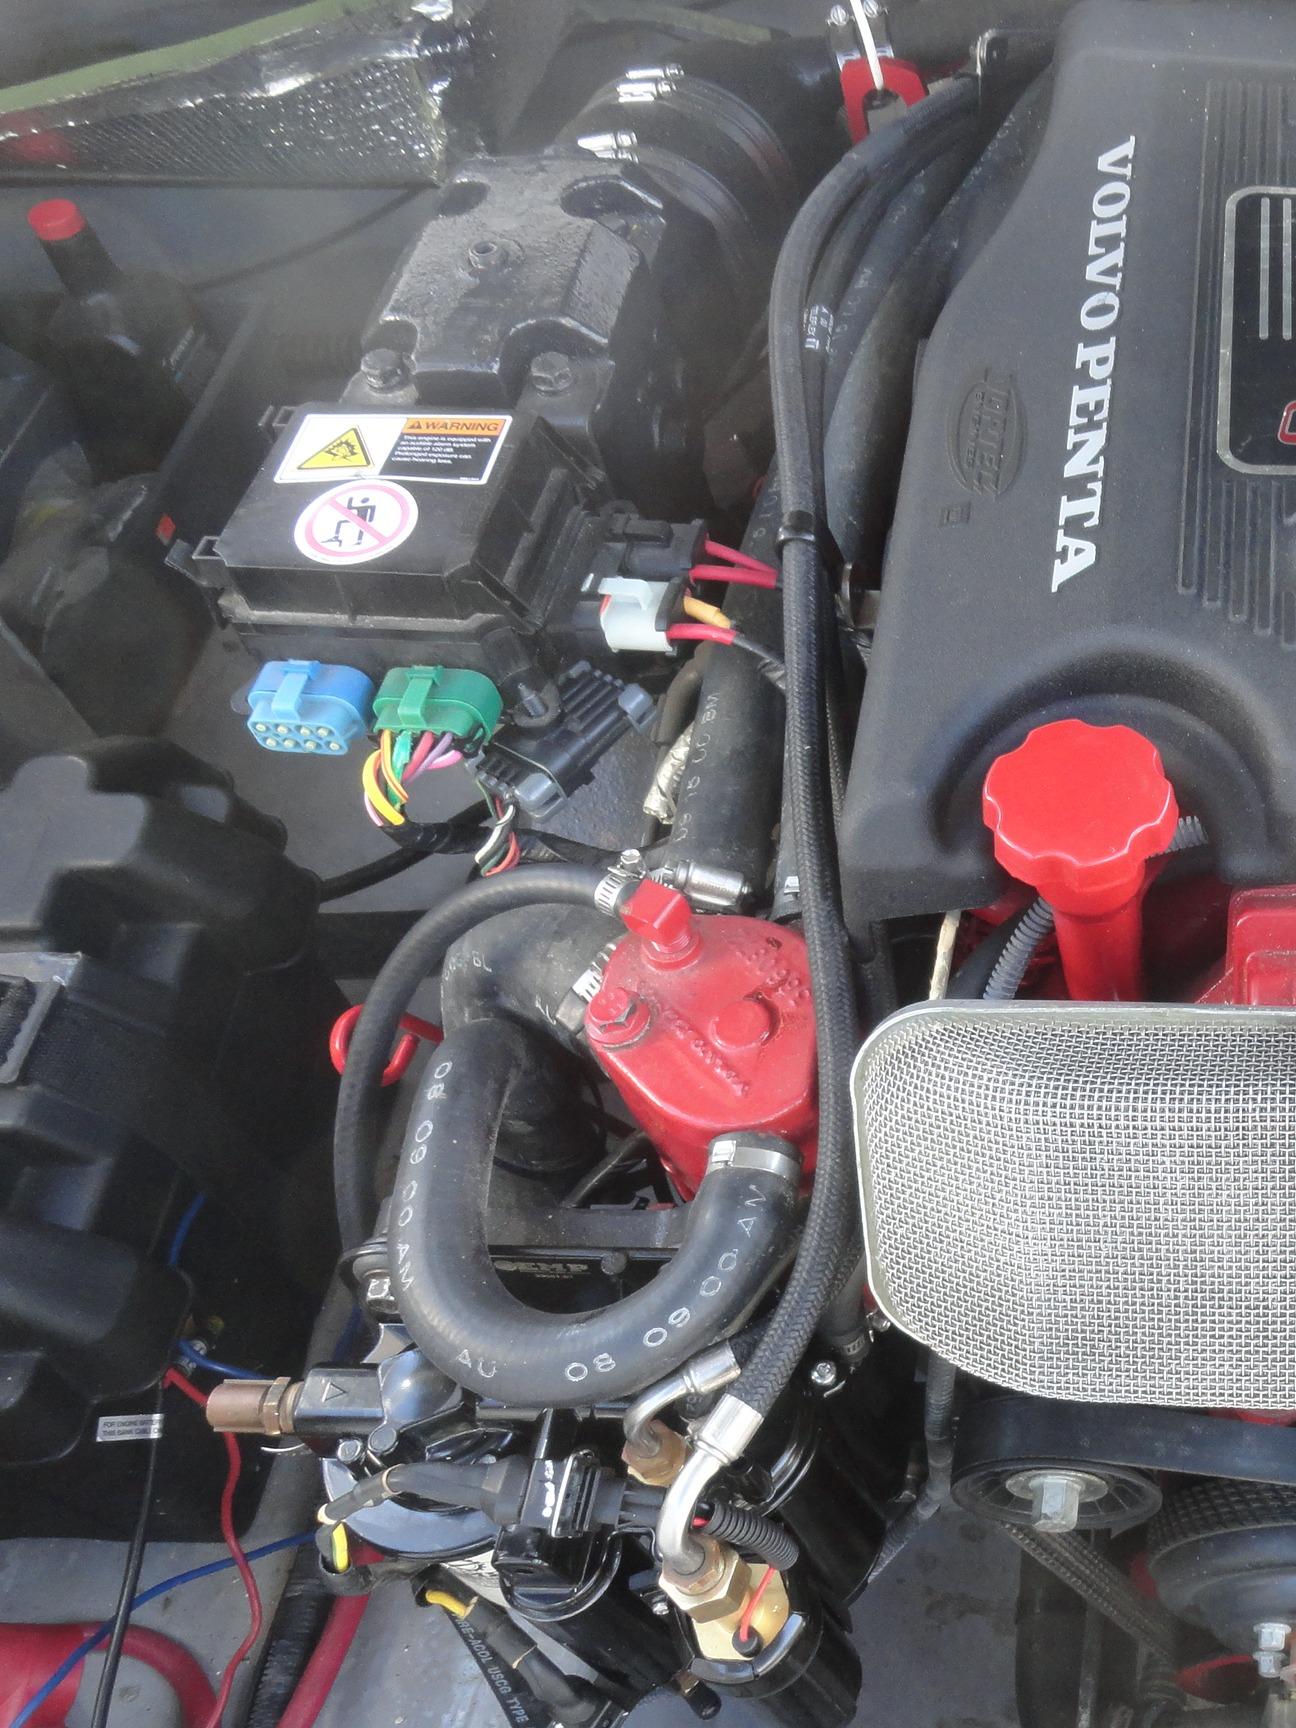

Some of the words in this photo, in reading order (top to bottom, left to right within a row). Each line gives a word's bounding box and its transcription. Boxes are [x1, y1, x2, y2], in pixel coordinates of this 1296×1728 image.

[1080, 135, 1136, 331] VOLVO
[425, 421, 499, 432] WARNING
[1051, 335, 1117, 593] PENTA
[564, 1352, 617, 1383] 08
[642, 1306, 692, 1348] 09
[487, 1665, 512, 1695] USCG
[506, 1694, 529, 1723] TYPE
